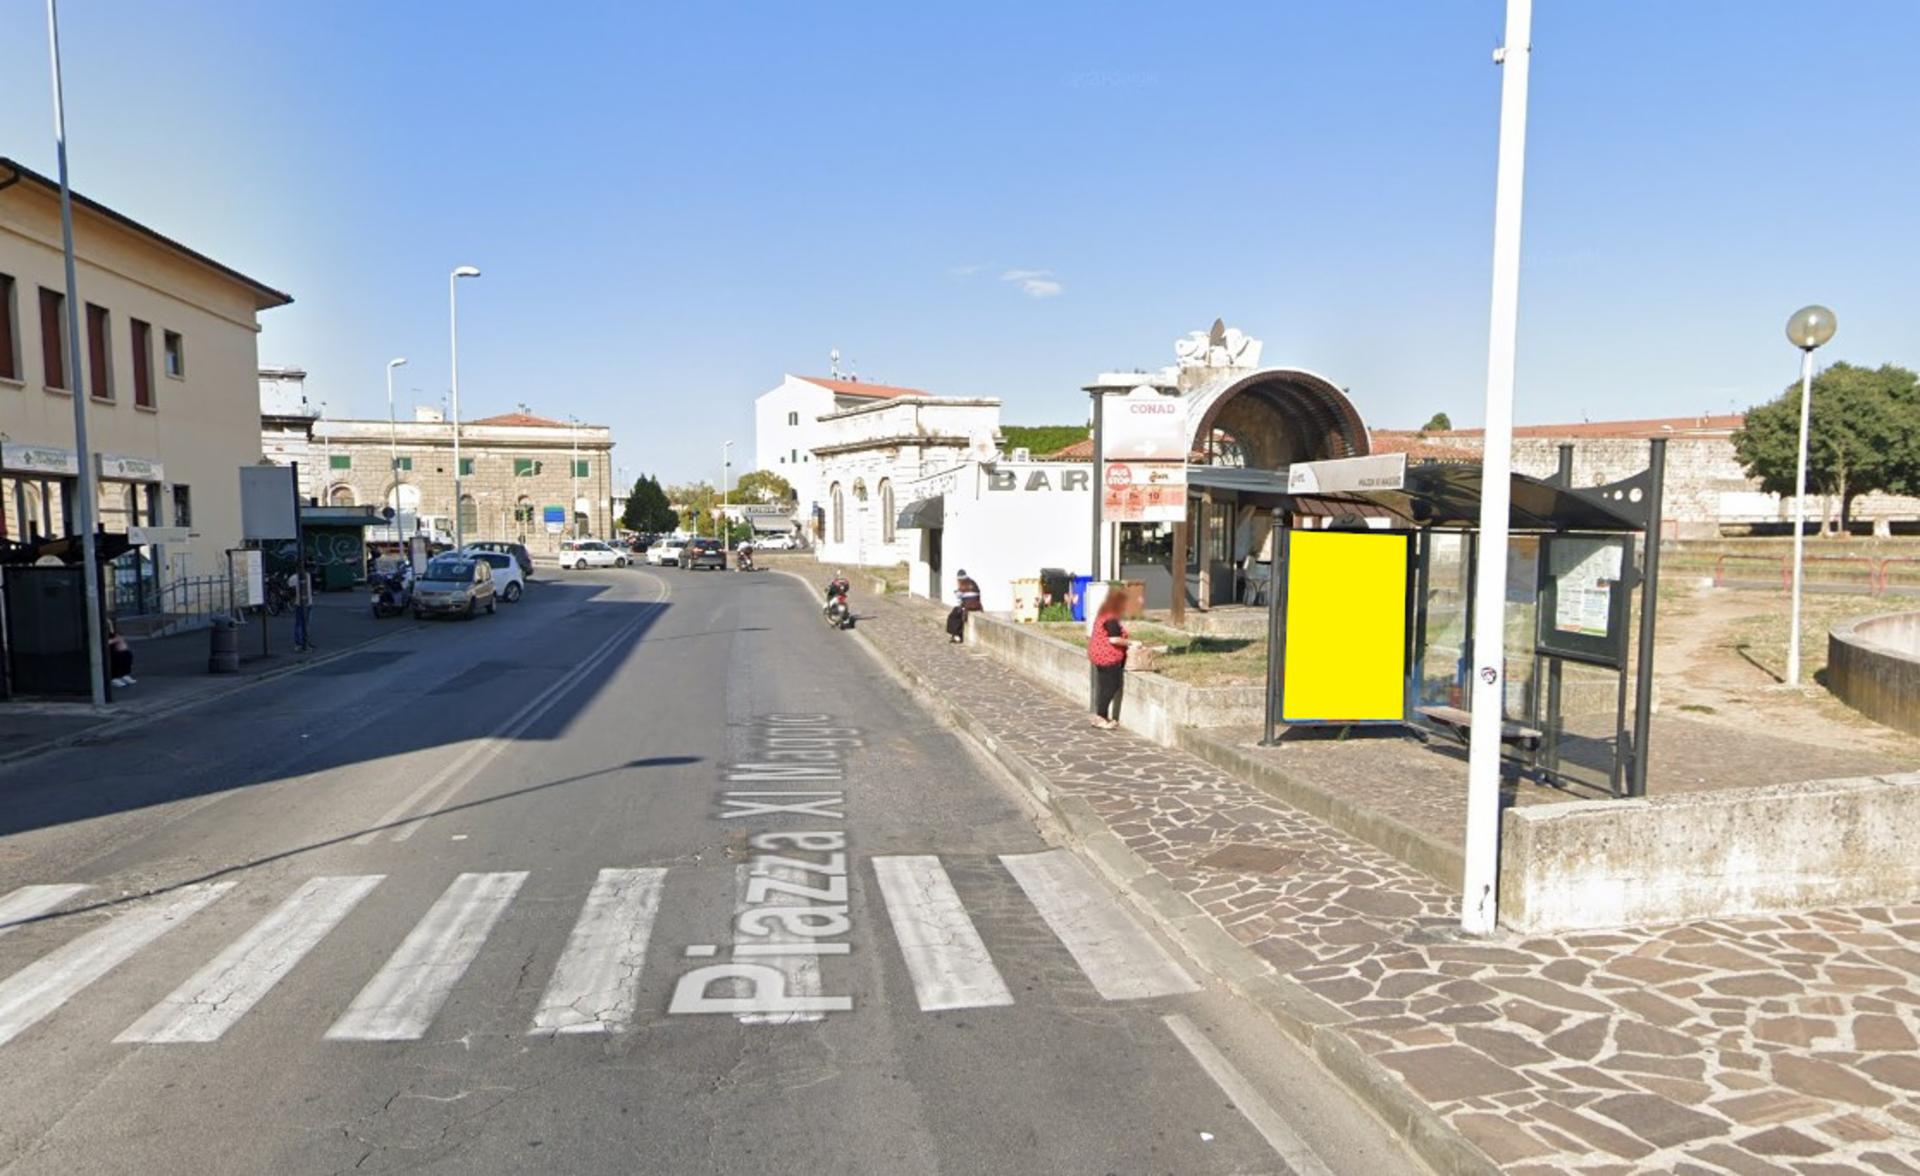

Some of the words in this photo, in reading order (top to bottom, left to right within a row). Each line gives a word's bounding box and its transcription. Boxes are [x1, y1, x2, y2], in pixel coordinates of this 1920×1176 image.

[1129, 403, 1176, 415] CONAD
[988, 469, 1090, 492] BAR
[1148, 491, 1160, 500] 10
